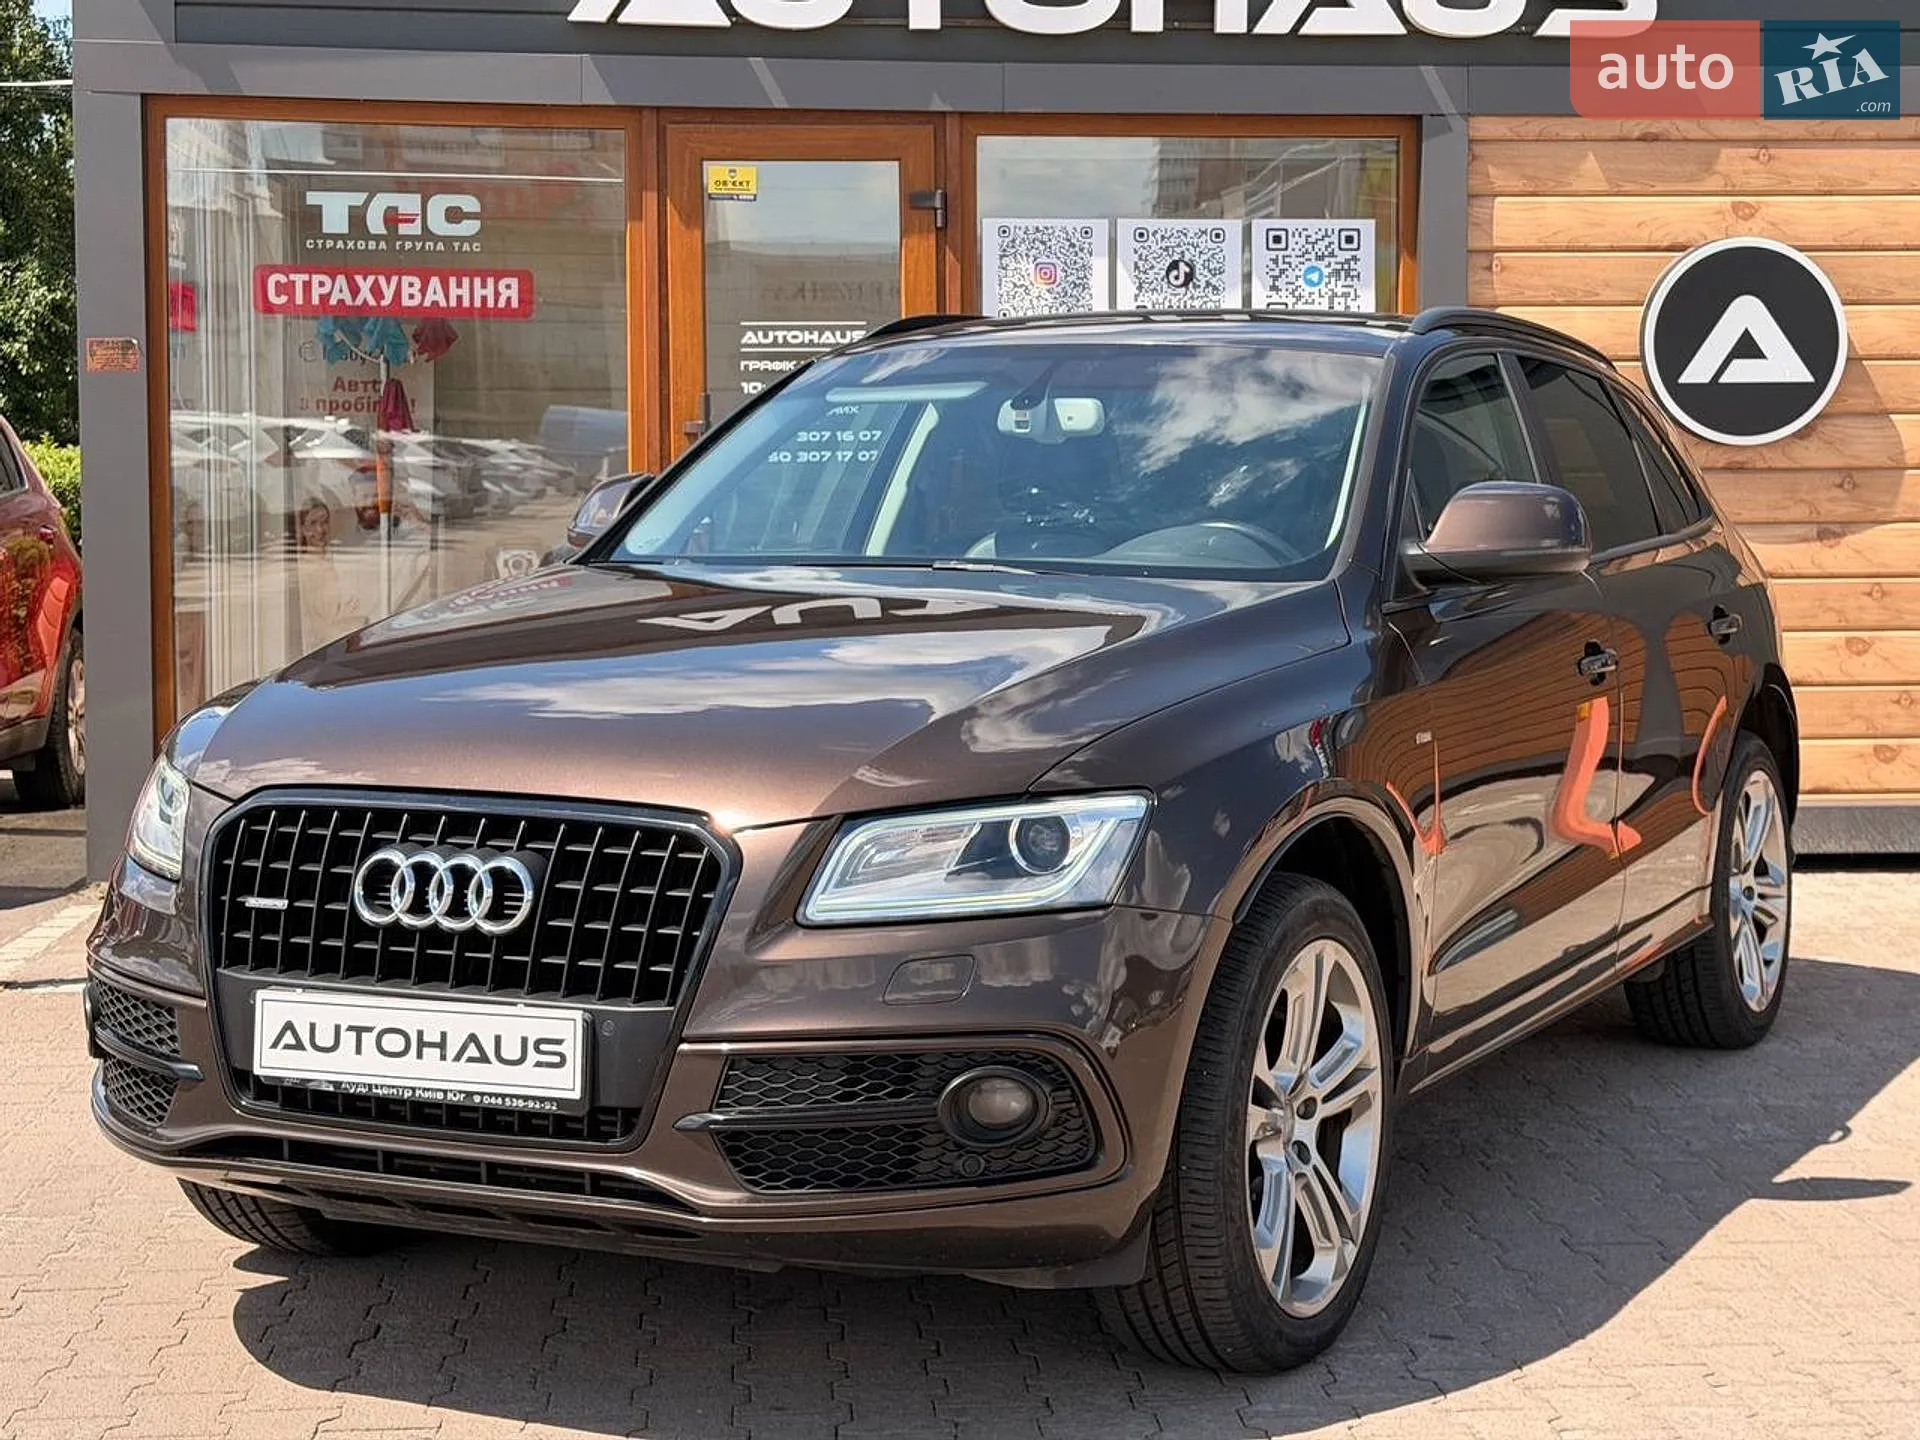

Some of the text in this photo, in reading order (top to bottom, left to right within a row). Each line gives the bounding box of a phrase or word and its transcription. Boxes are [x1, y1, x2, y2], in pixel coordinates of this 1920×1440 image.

[306, 239, 482, 253] СТРАХОВА ГРУПА ТАС
[267, 272, 519, 309] СТРАХУВАННЯ
[741, 330, 867, 344] AUTOHAUS
[740, 359, 796, 372] ГРАФІК
[797, 430, 832, 442] 307
[859, 430, 882, 442] 07
[836, 450, 854, 462] 17
[268, 1019, 568, 1069] AUTOHAUS
